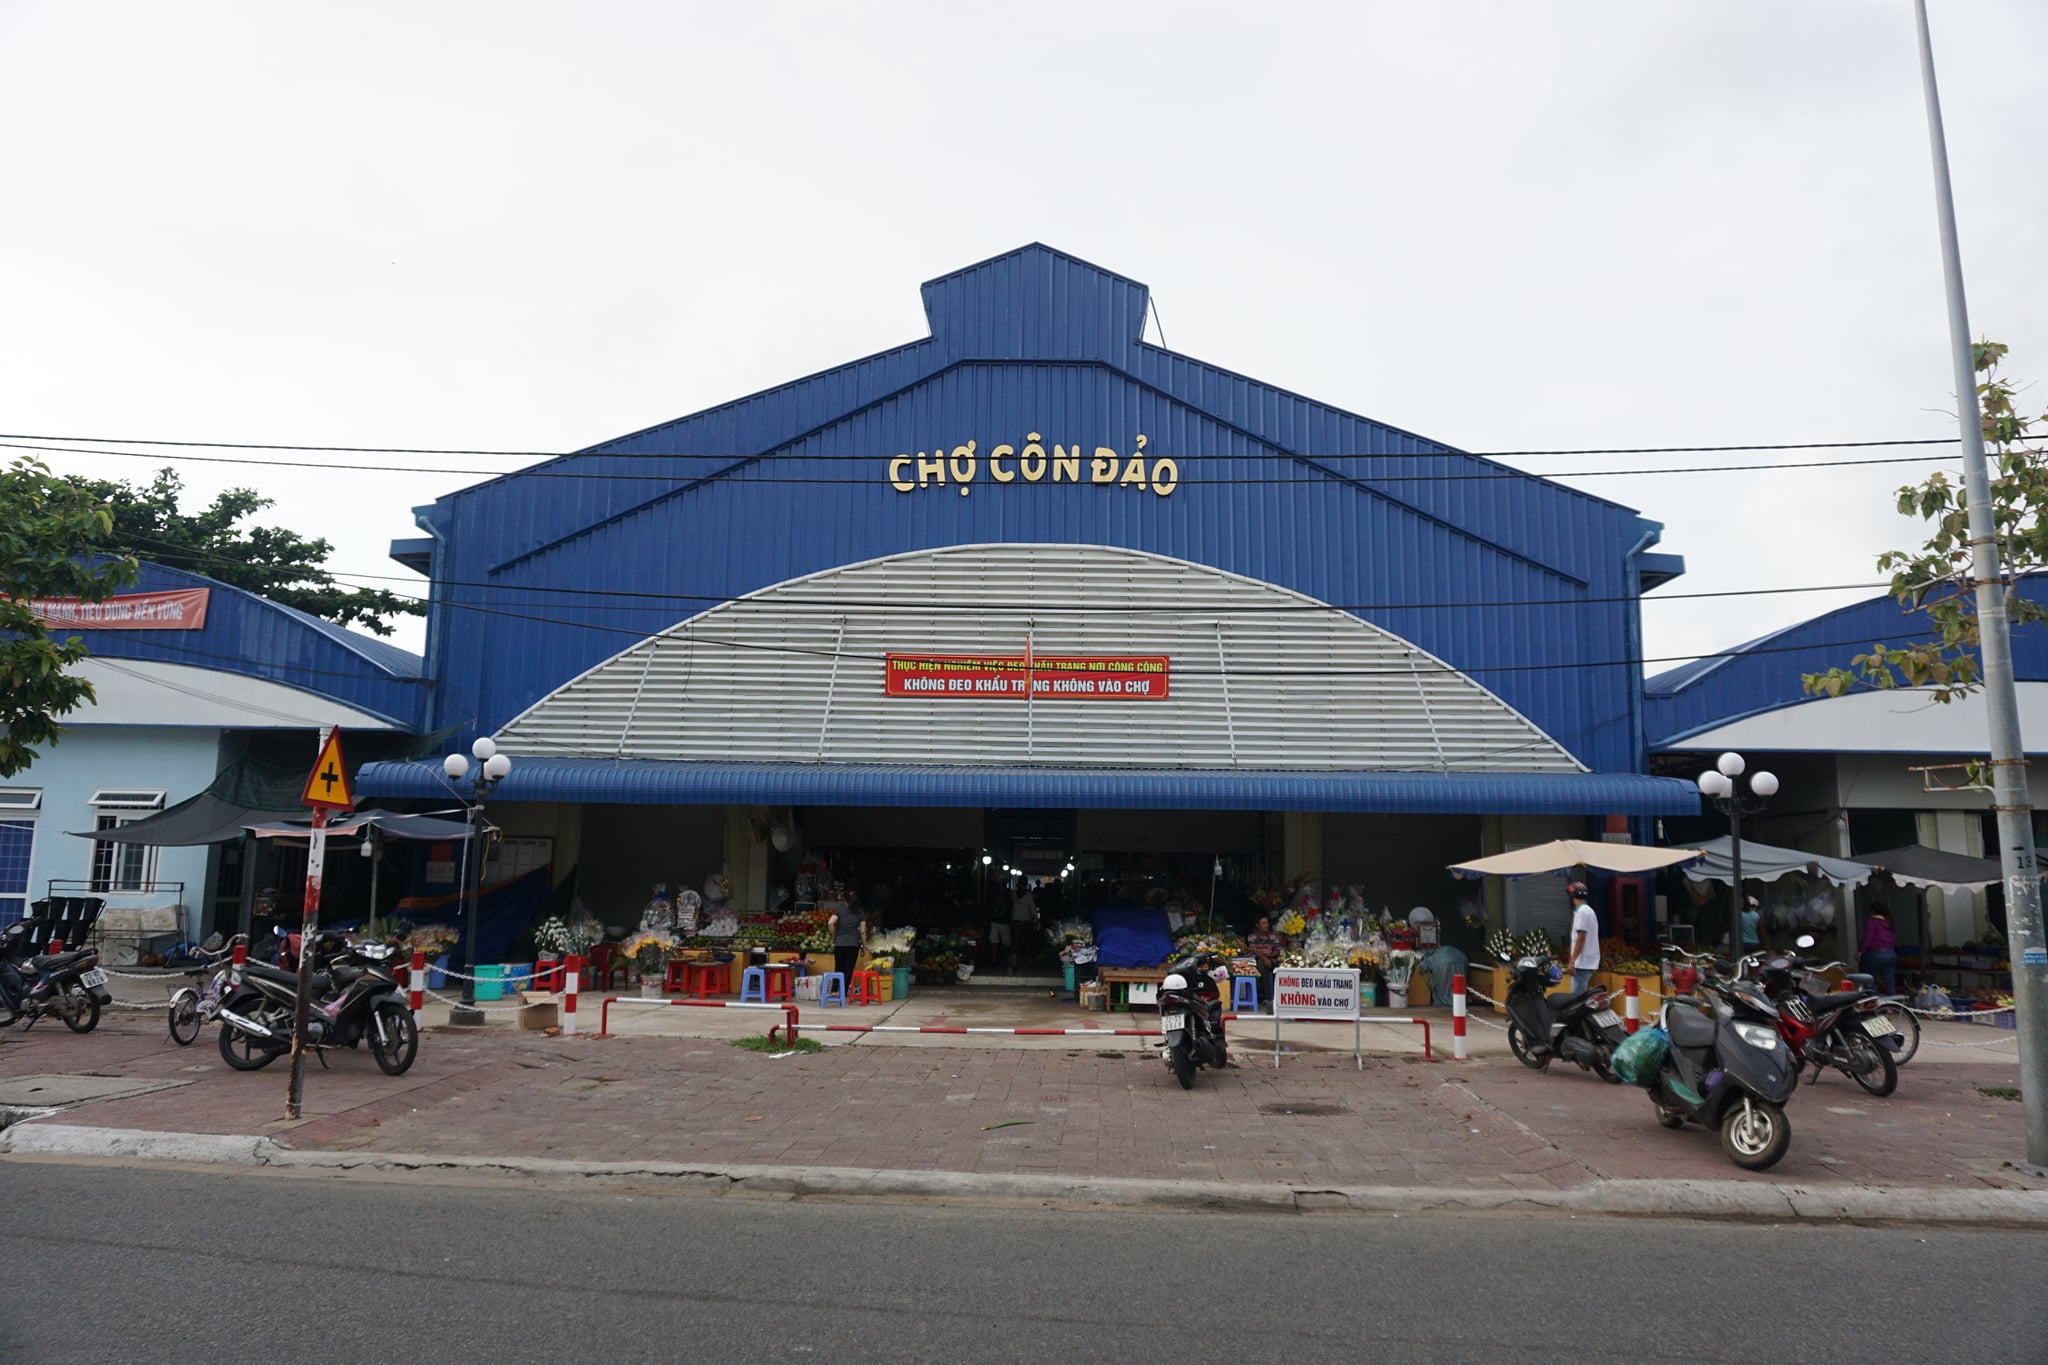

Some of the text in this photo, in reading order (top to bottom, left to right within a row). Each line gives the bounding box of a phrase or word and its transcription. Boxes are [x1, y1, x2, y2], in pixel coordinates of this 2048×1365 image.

[889, 431, 1179, 497] CHỢ CÔN ĐẢO
[892, 660, 917, 673] THỰC
[918, 659, 941, 673] HIỆN
[983, 659, 1005, 673] VIỆC
[1033, 658, 1053, 672] HẨU
[1056, 661, 1086, 672] TRANG
[1108, 661, 1134, 672] CÔNG
[1137, 661, 1163, 675] CỘNG
[904, 675, 1150, 695] KHÔNG ĐEO KHẨU TRNG KHÔNG VÀO CHỢ
[1278, 975, 1300, 988] KHÔNG
[1301, 977, 1313, 988] ĐEO
[1315, 975, 1331, 989] KHẨU
[1333, 978, 1353, 990] TRANG
[1280, 991, 1350, 1008] KHÔNG VÀO CHỢ
